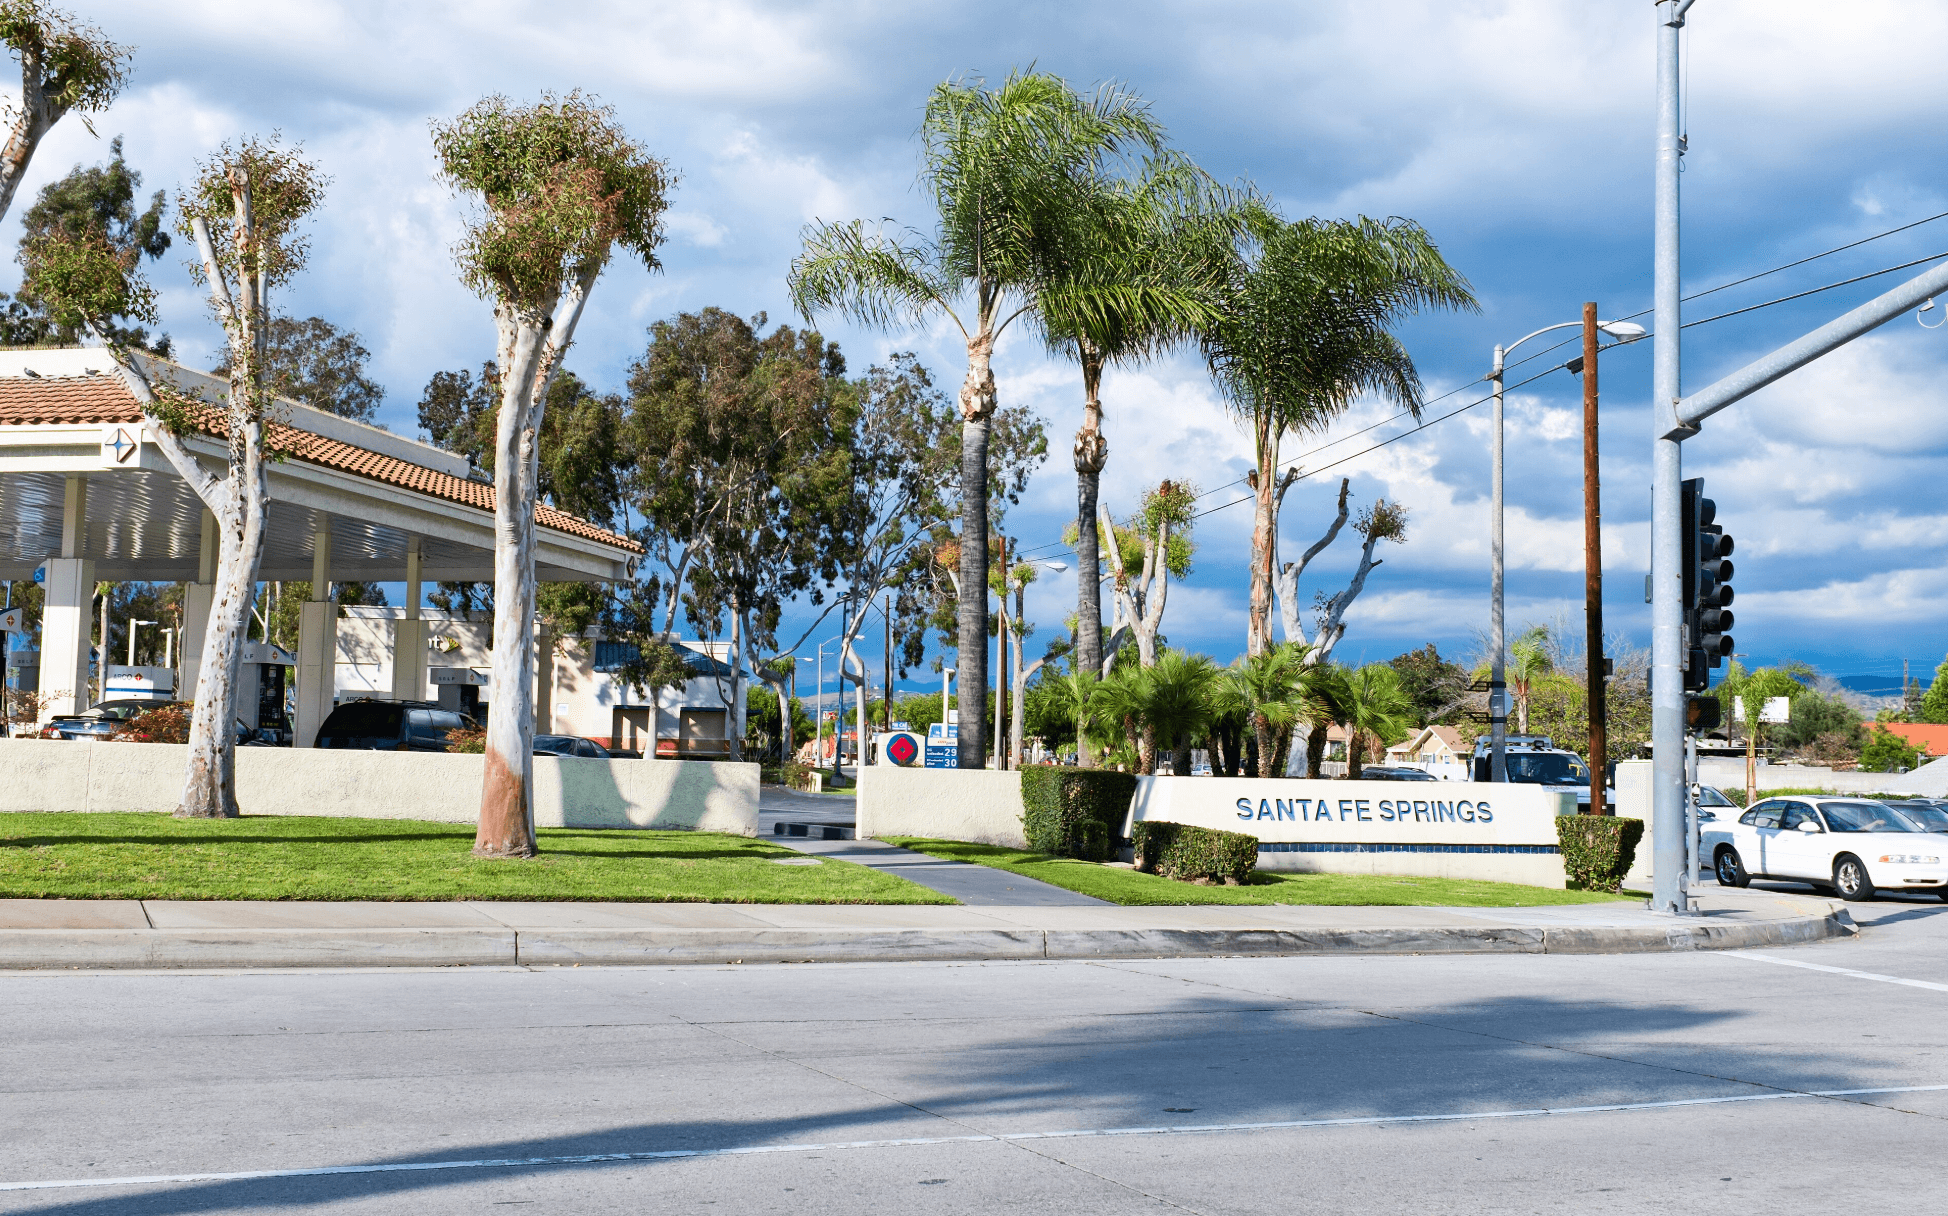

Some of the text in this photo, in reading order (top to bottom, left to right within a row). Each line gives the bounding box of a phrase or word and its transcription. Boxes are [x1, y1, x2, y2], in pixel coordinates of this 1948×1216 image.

[1236, 797, 1494, 823] SANTA FE SPRINGS
